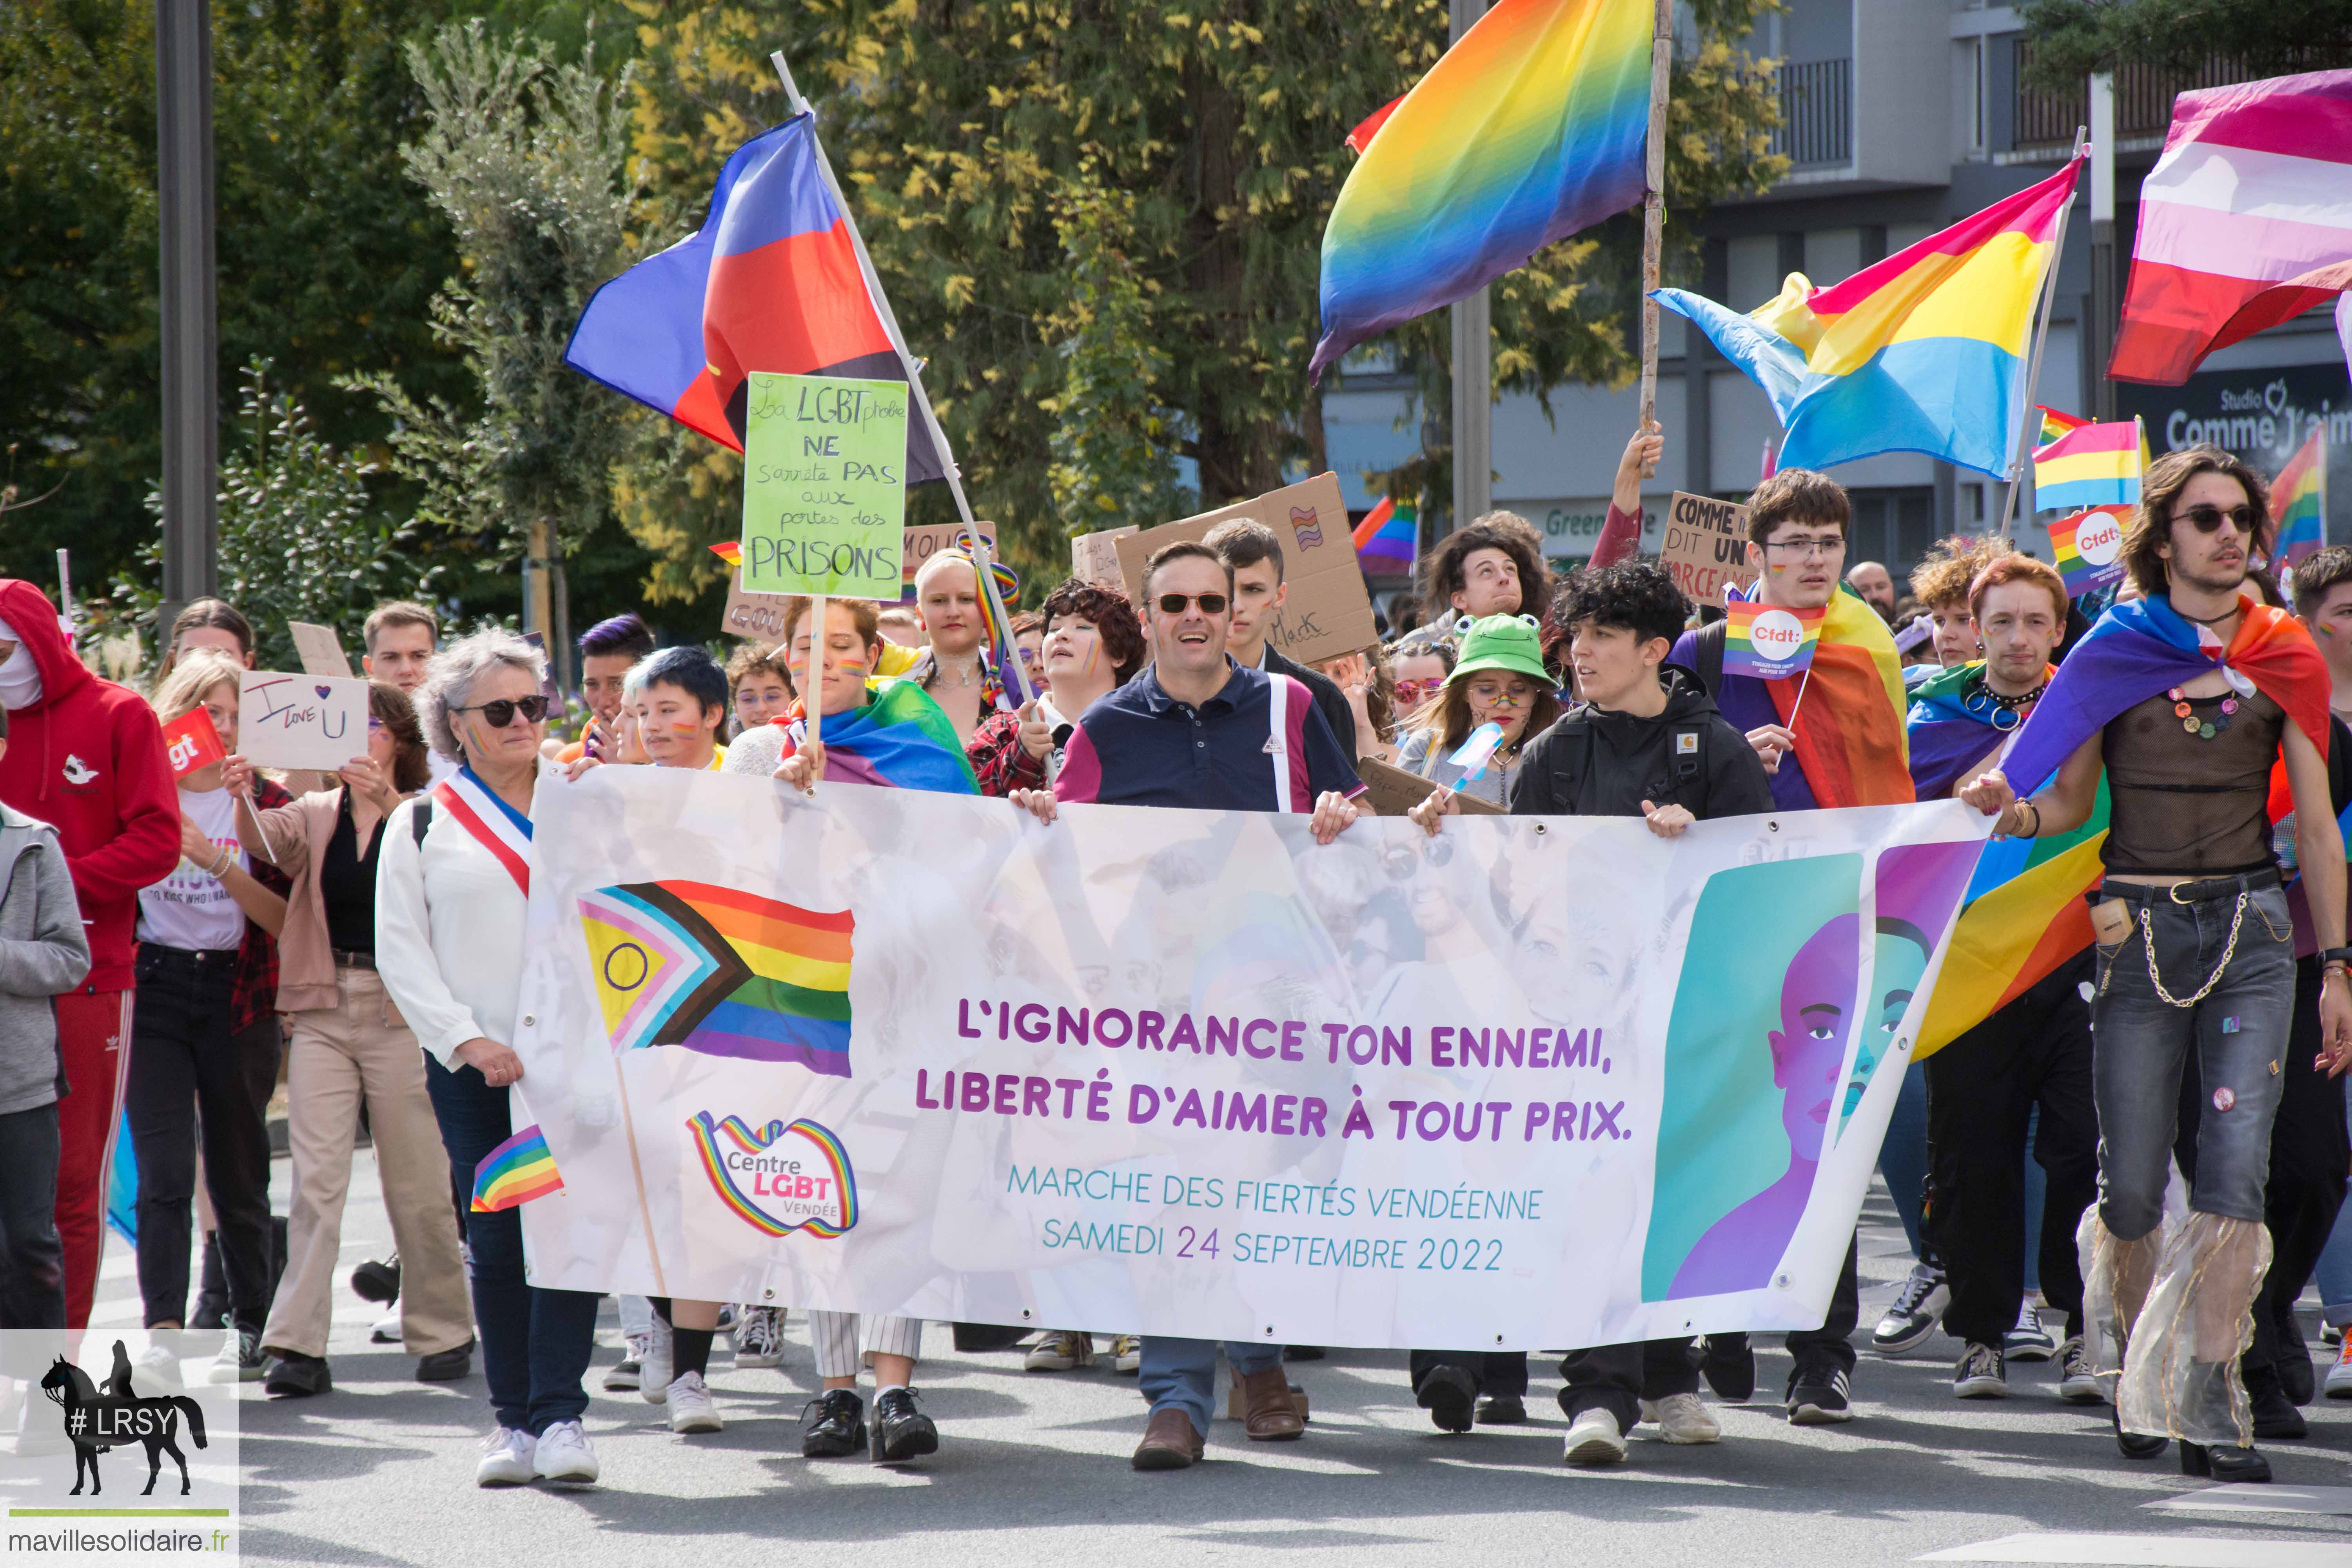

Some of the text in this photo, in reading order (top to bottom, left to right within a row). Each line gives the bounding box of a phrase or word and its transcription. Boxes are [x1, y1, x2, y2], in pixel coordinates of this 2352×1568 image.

[749, 377, 790, 420] La
[2221, 388, 2262, 410] Studio
[804, 436, 840, 457] NE
[2166, 409, 2275, 453] Comme
[843, 461, 897, 484] PAS
[802, 491, 855, 505] aux
[781, 510, 886, 533] portes des
[1675, 498, 1735, 535] COMME
[1668, 528, 1747, 566] DIT UN
[1755, 627, 1799, 642] Cfdt:
[243, 678, 345, 739] I LOVE U
[186, 893, 206, 904] WHO
[958, 998, 1611, 1074] L'IGNORANCE TON ENNEMI,
[916, 1068, 1632, 1142] LIBERTÉ D'AIMER À TOUT PRIX.
[728, 1152, 801, 1175] Centre
[754, 1172, 831, 1200] LGBT
[1007, 1165, 1543, 1220] MARCHE DES FIERTÉS VENDÉENNE
[1043, 1219, 1503, 1270] SAMEDI 24 SEPTEMBRE 2022
